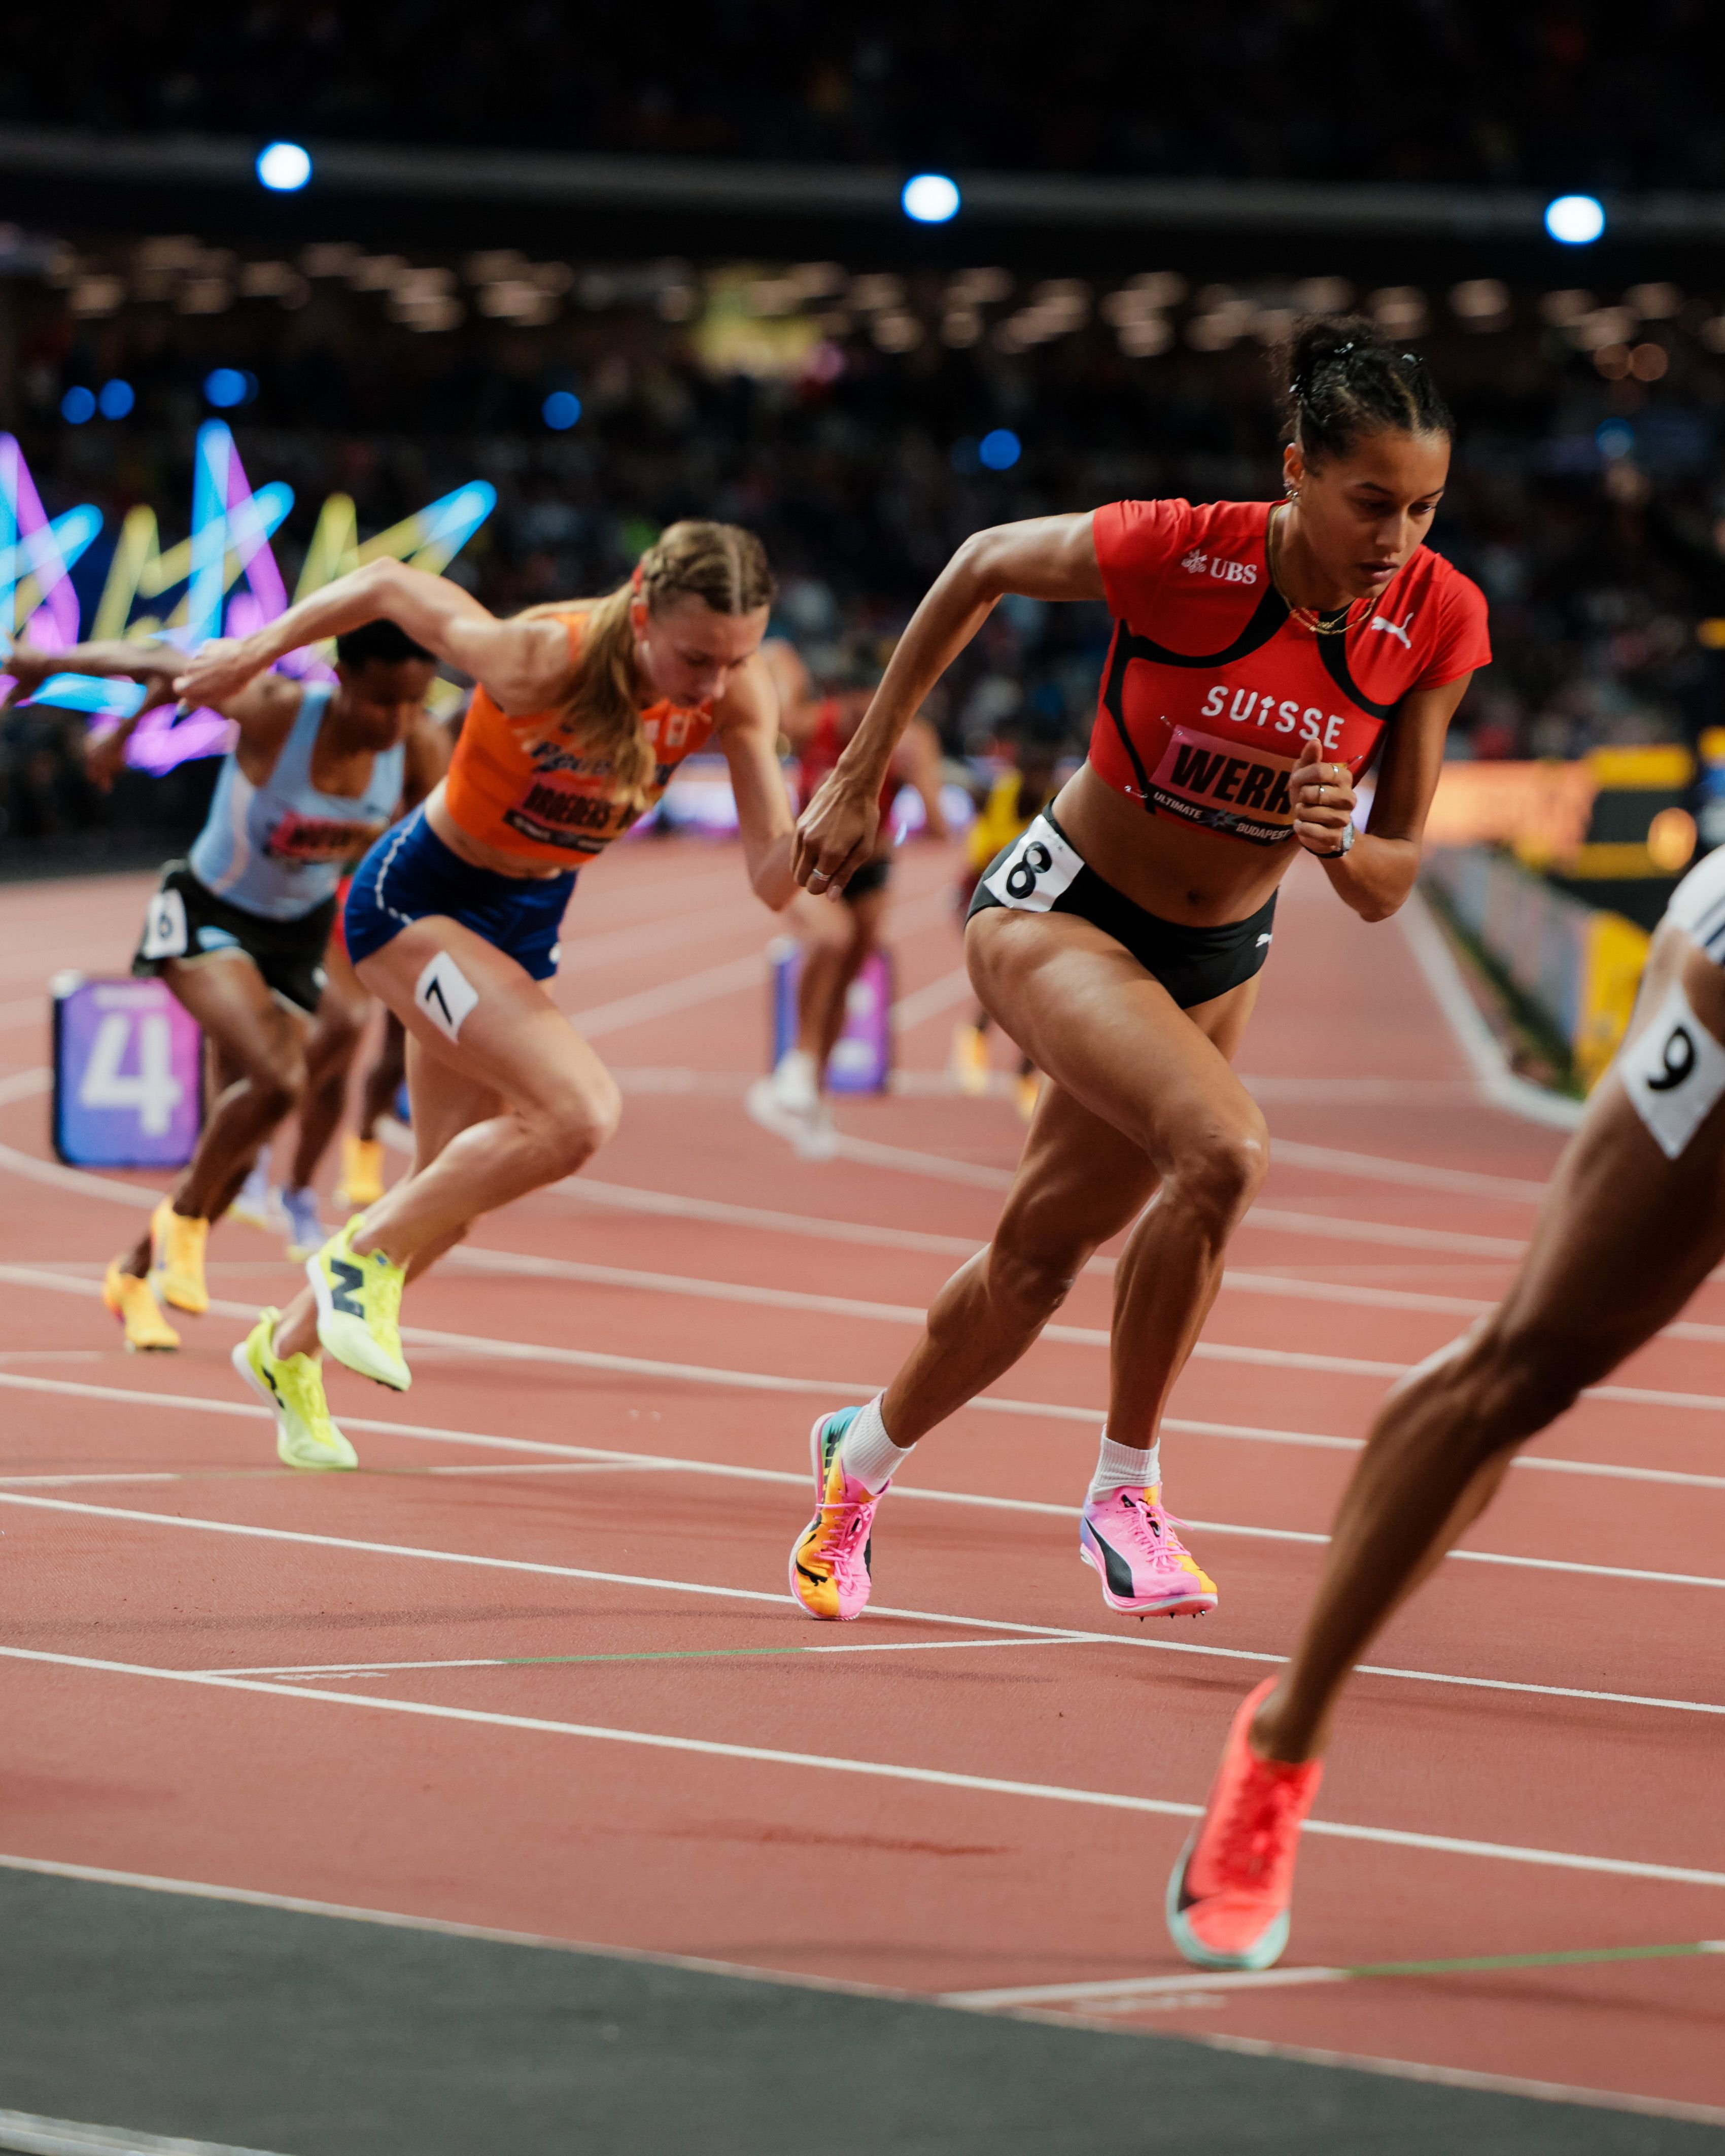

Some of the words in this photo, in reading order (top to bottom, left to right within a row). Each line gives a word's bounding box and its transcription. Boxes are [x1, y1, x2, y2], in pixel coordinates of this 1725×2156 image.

[1210, 557, 1258, 585] UBS
[1153, 791, 1202, 819] ULTIMATE
[1235, 822, 1292, 840] BUDAPEST
[1006, 841, 1052, 899] 8
[425, 975, 453, 1027] 7
[79, 1013, 183, 1137] 4
[1647, 1025, 1697, 1091] 9
